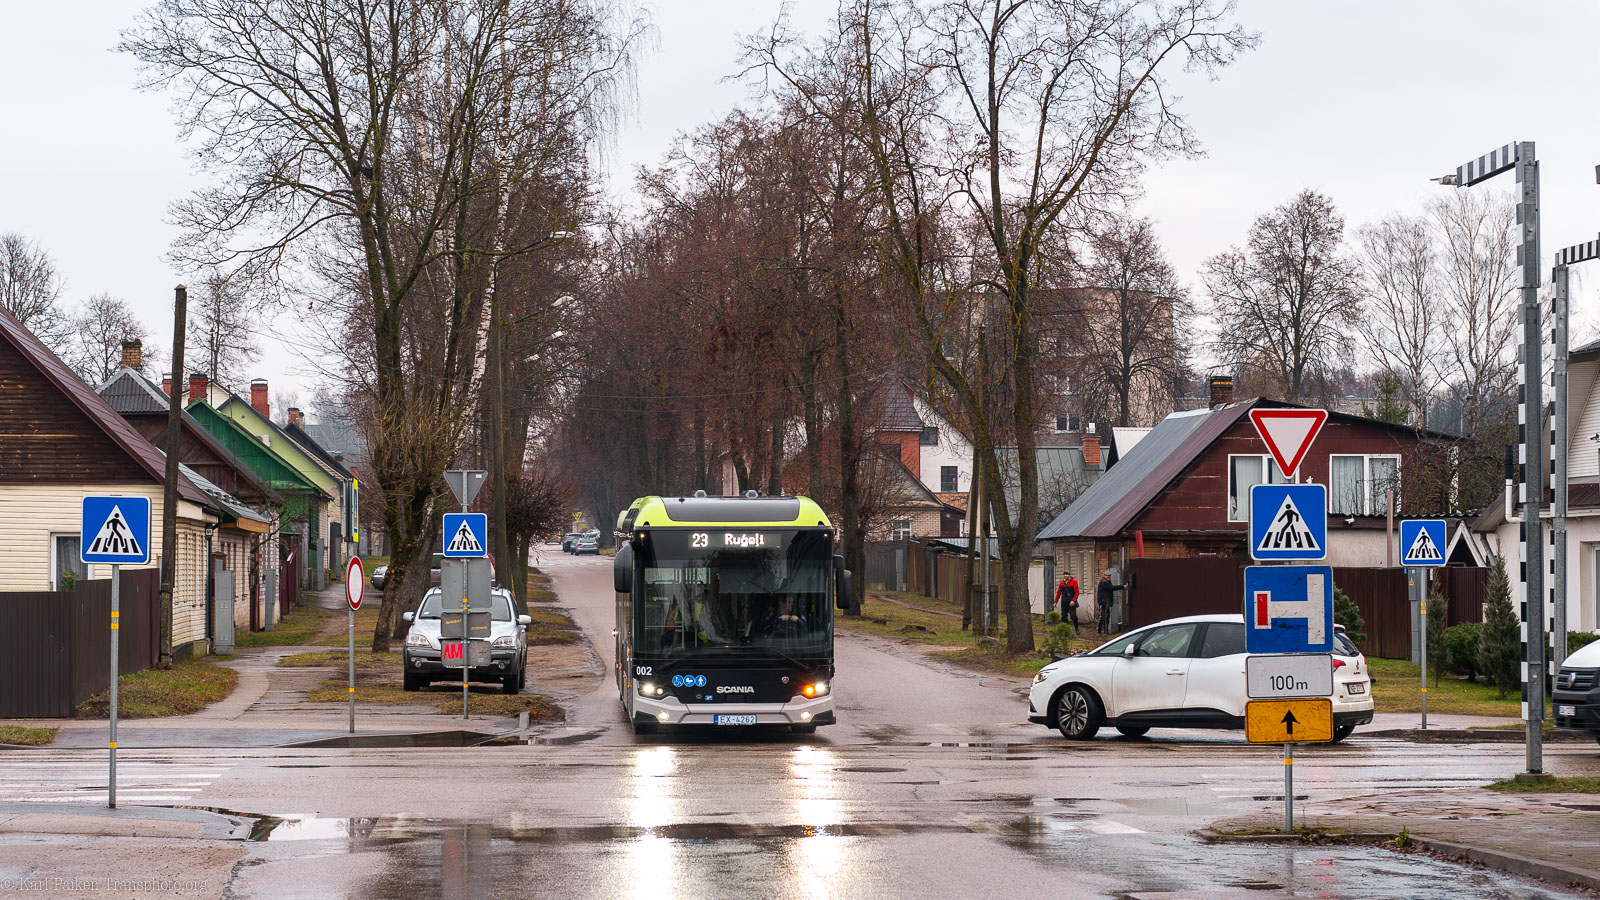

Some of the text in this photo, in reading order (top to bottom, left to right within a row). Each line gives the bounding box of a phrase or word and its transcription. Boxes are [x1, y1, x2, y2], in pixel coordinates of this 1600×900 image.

[692, 532, 709, 548] 23
[636, 666, 653, 676] 002
[716, 686, 755, 694] SCANIA
[719, 715, 756, 723] EX-4262
